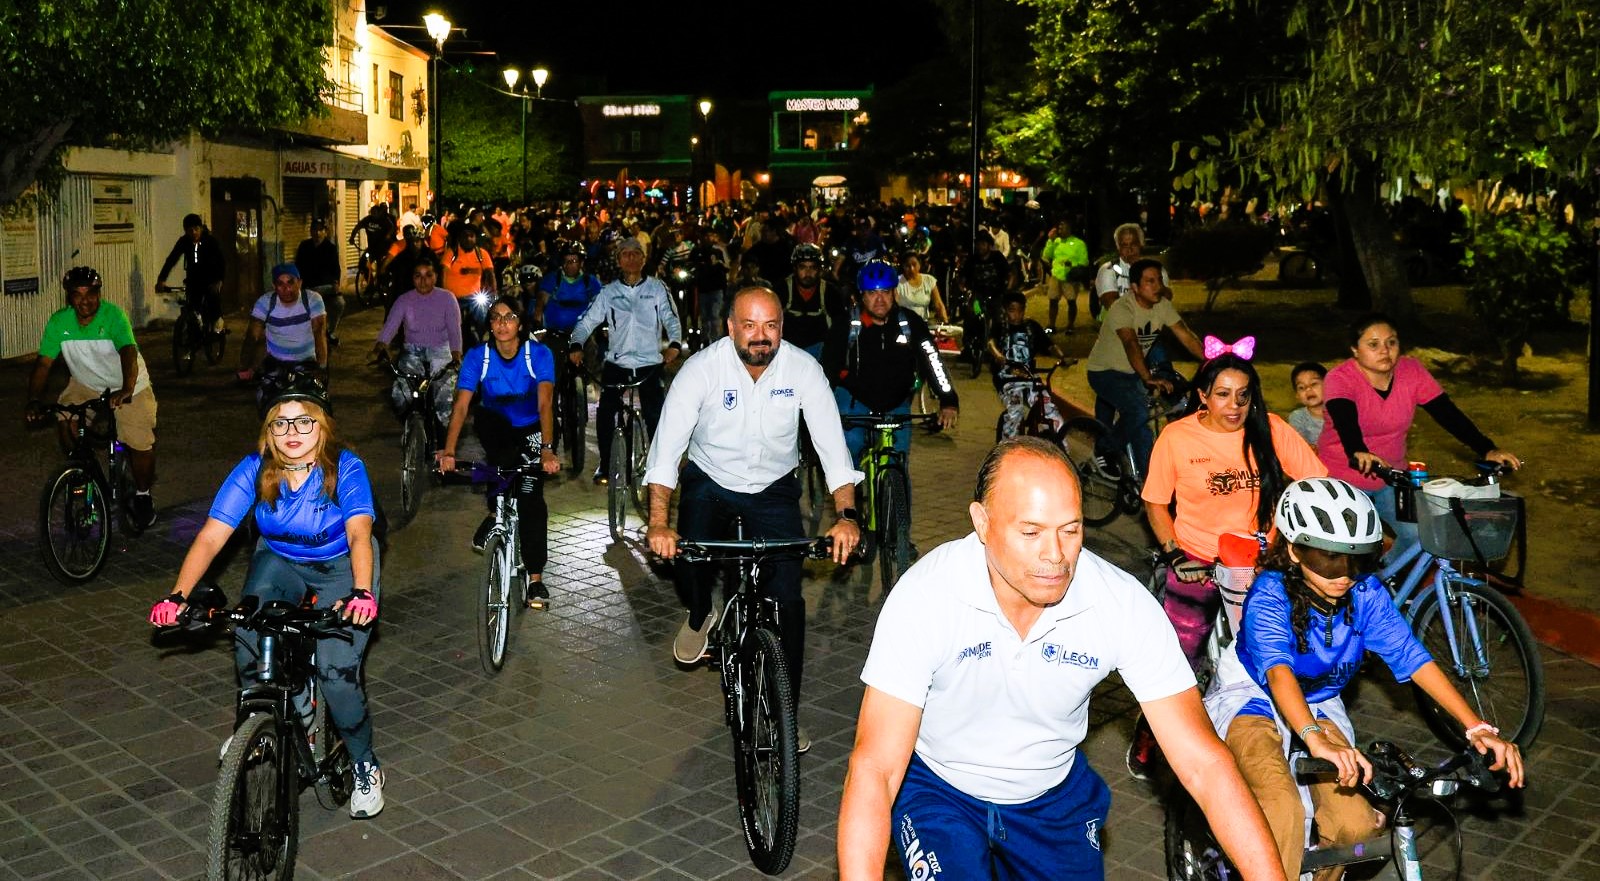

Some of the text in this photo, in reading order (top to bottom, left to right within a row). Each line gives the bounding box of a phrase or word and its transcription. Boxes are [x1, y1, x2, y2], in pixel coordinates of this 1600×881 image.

[787, 98, 859, 111] MASTER WINGS
[284, 161, 317, 174] AGUAS
[1063, 650, 1099, 667] LEÓN
[926, 850, 942, 875] 2023
